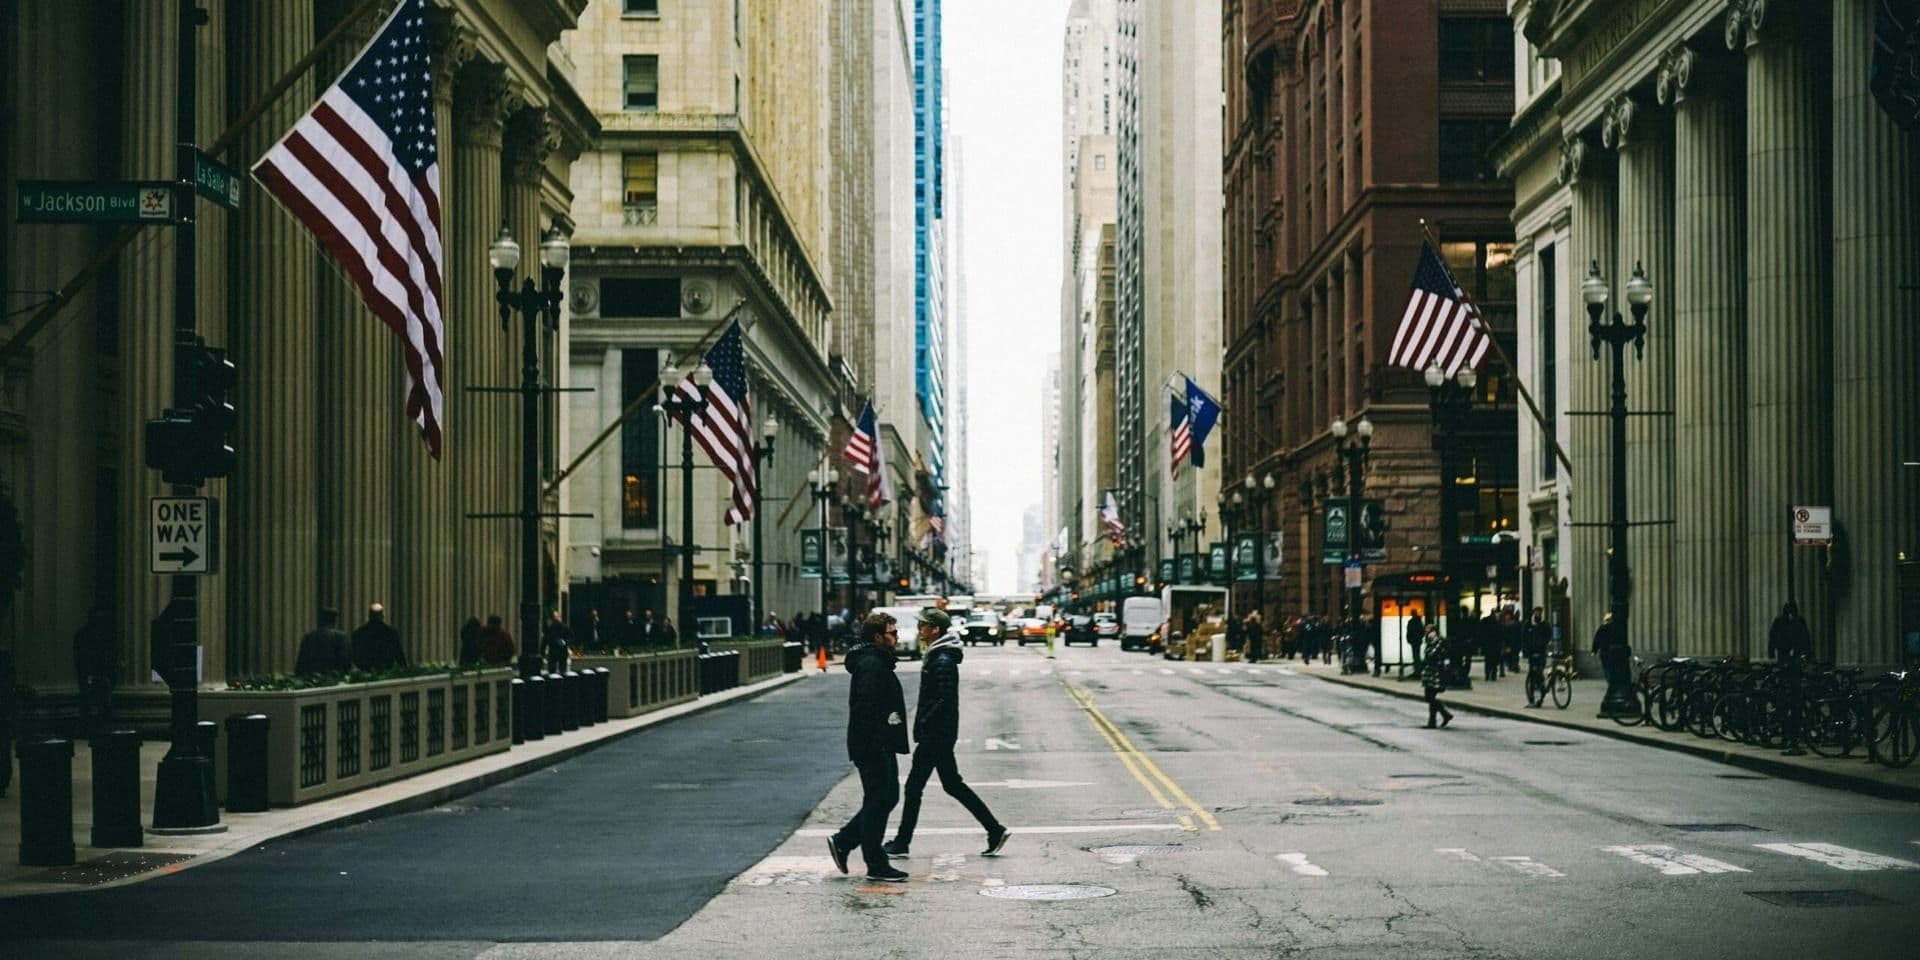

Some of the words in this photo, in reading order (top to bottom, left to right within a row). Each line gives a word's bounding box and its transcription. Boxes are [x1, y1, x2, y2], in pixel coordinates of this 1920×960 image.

[197, 161, 206, 184] La
[207, 167, 225, 194] Salle
[23, 195, 32, 207] W
[35, 191, 105, 212] Jackson
[110, 197, 136, 208] Blvd
[158, 503, 202, 522] ONE
[157, 525, 203, 543] WAY
